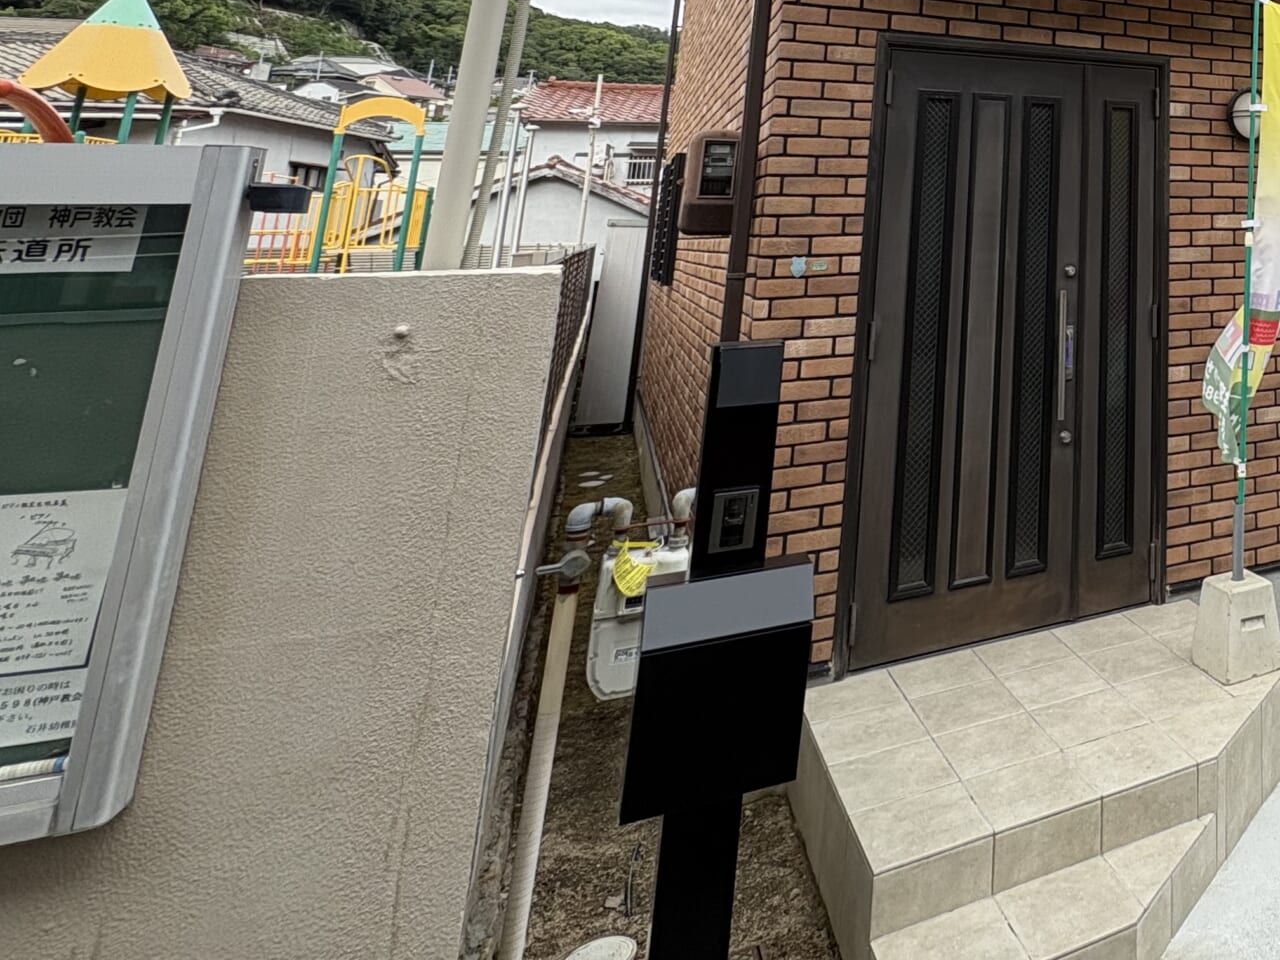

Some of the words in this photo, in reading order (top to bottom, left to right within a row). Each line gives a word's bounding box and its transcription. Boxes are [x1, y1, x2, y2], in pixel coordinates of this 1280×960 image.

[0, 206, 27, 228] 団
[48, 205, 138, 228] 神戸教会
